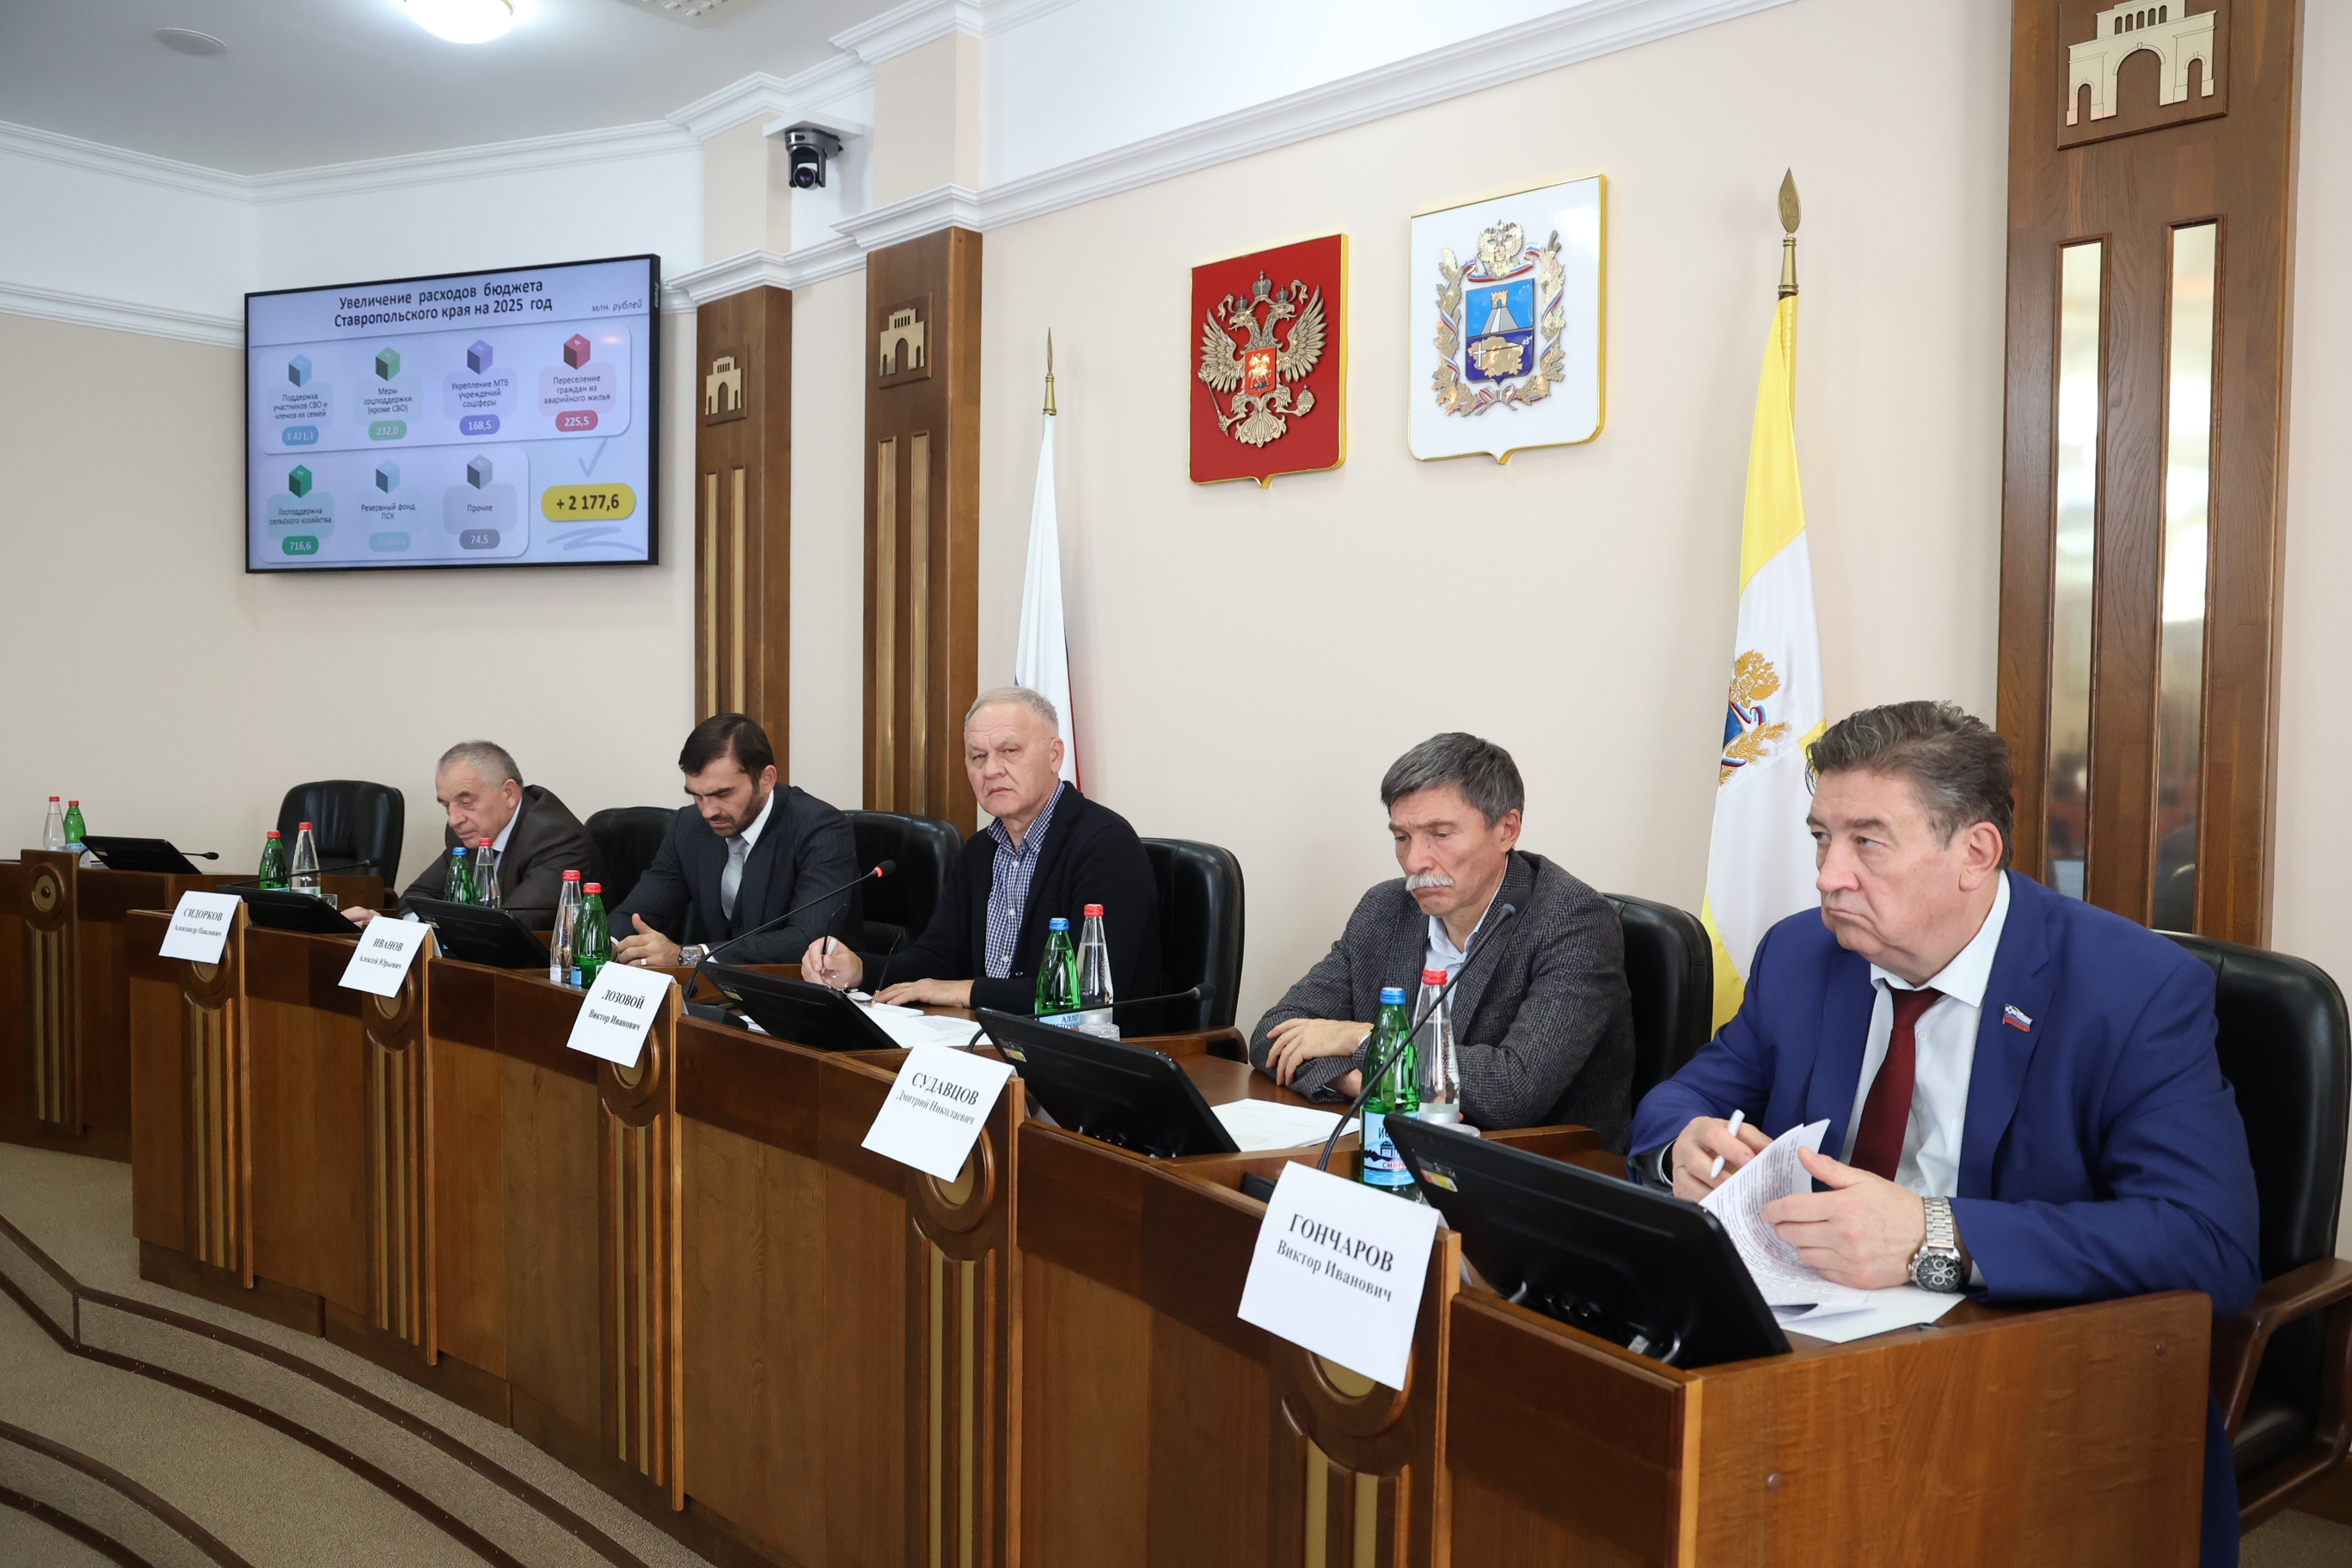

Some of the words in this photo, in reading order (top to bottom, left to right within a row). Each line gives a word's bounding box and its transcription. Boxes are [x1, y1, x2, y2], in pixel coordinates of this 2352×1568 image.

[340, 293, 412, 310] Увеличение
[419, 287, 476, 305] расходов
[484, 280, 543, 297] бюджета
[591, 303, 610, 312] млн.
[612, 298, 643, 312] рублей
[334, 308, 438, 328] Ставропольского
[441, 304, 471, 321] края
[475, 303, 489, 315] на
[493, 298, 523, 313] 2025
[530, 297, 552, 311] год
[450, 381, 492, 390] Укрепление
[553, 375, 601, 385] Переселение
[458, 389, 501, 400] учреждений
[556, 386, 587, 395] граждан
[282, 394, 318, 402] Поддержка
[363, 395, 412, 406] соцподдержки
[462, 398, 496, 409] соцсферы
[543, 395, 585, 404] аварийного
[273, 403, 308, 413] участников
[367, 406, 390, 414] (кроме
[392, 404, 407, 413] СВО)
[306, 409, 326, 419] семей
[468, 420, 492, 432] 168,5
[564, 415, 590, 427] 225,5
[377, 426, 399, 436] 232,0
[361, 503, 396, 512] Резервный
[397, 503, 415, 511] фонд
[568, 495, 577, 510] 2
[581, 493, 619, 511] 177,6
[279, 507, 322, 517] Господдержка
[467, 504, 493, 512] Прочие
[470, 535, 489, 545] 74,5
[290, 542, 311, 551] 716,6
[183, 908, 224, 922] СИДОРКОВ
[174, 924, 198, 935] Александр
[198, 927, 222, 937] Павлович
[372, 938, 404, 952] ИВАНОВ
[358, 954, 378, 965] Алексей
[378, 958, 402, 970] Юрьевич
[601, 989, 646, 1009] ЛОЗОВОЙ
[588, 1008, 610, 1024] Виктор
[610, 1014, 641, 1031] Иванович
[1062, 1014, 1080, 1023] АЛЛЕ
[911, 1072, 979, 1106] СУДАВЦОВ
[895, 1089, 931, 1109] Дмитрий
[928, 1100, 975, 1125] Николаевич
[1288, 1212, 1394, 1273] ГОНЧАРОВ
[1277, 1239, 1322, 1274] Виктор
[1324, 1259, 1393, 1302] Иванович
